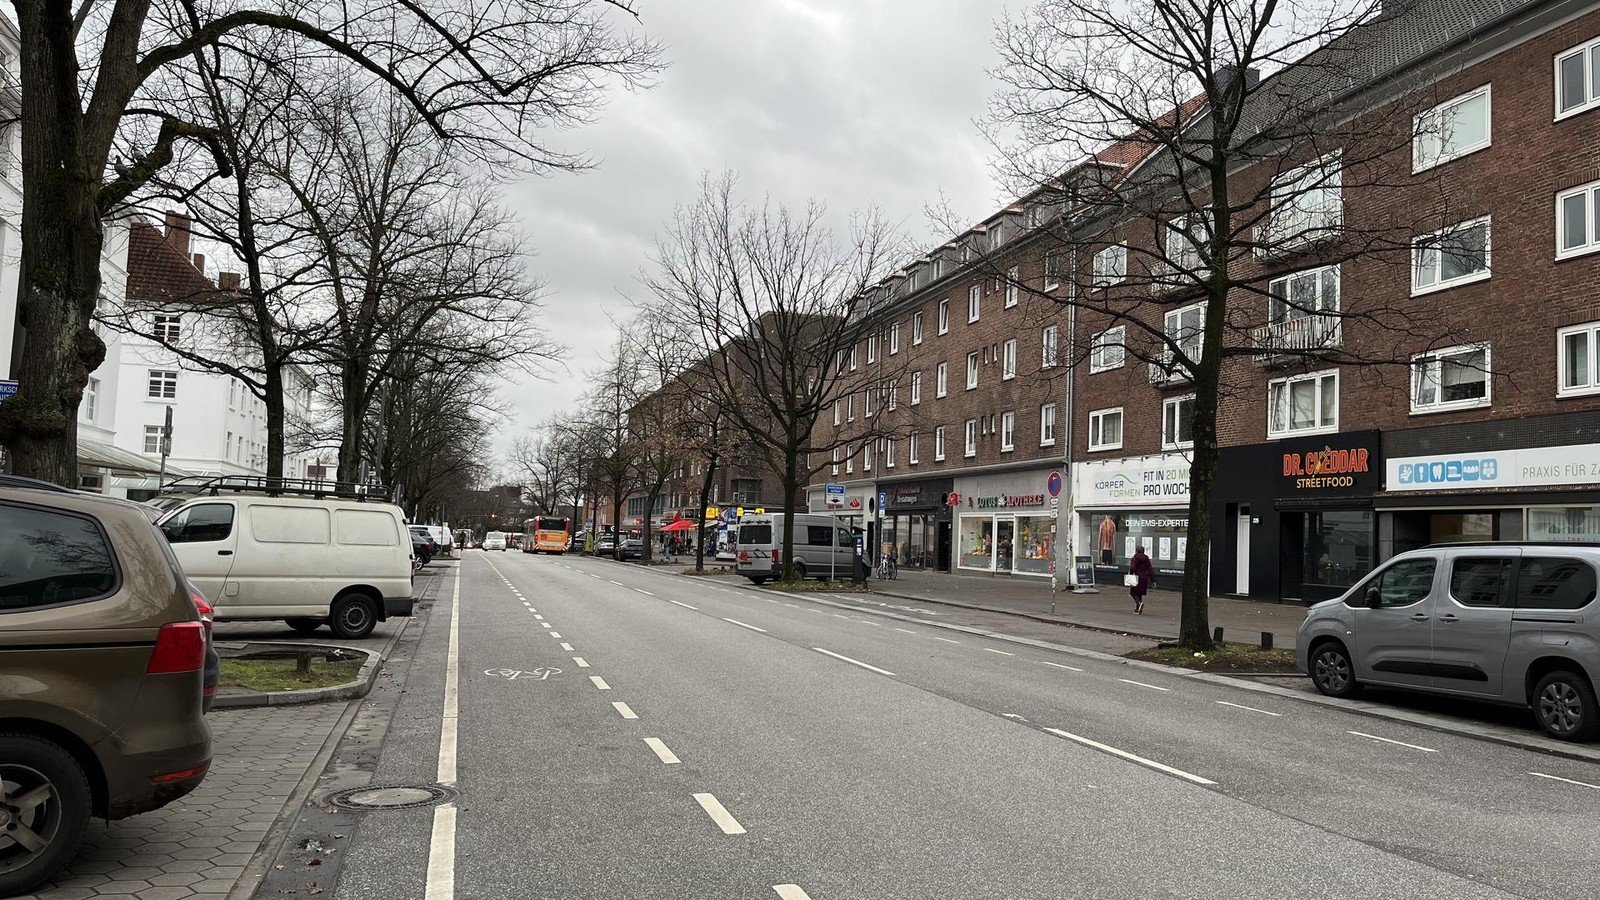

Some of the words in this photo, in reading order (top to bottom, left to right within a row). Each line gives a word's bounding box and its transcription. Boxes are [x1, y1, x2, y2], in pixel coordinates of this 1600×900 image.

[1283, 453, 1304, 476] DR.
[1305, 448, 1368, 475] CHEDDAR
[1143, 471, 1155, 481] FIT
[1156, 470, 1164, 481] IN
[1166, 469, 1177, 480] 20
[1522, 465, 1560, 478] PRAXIS
[1565, 462, 1586, 477] FÜR
[1590, 463, 1600, 476] Z
[1296, 476, 1354, 489] STREETFOOD
[1109, 488, 1141, 498] FORMEN
[1143, 484, 1161, 497] PRO
[1006, 493, 1044, 507] APOTHEKE
